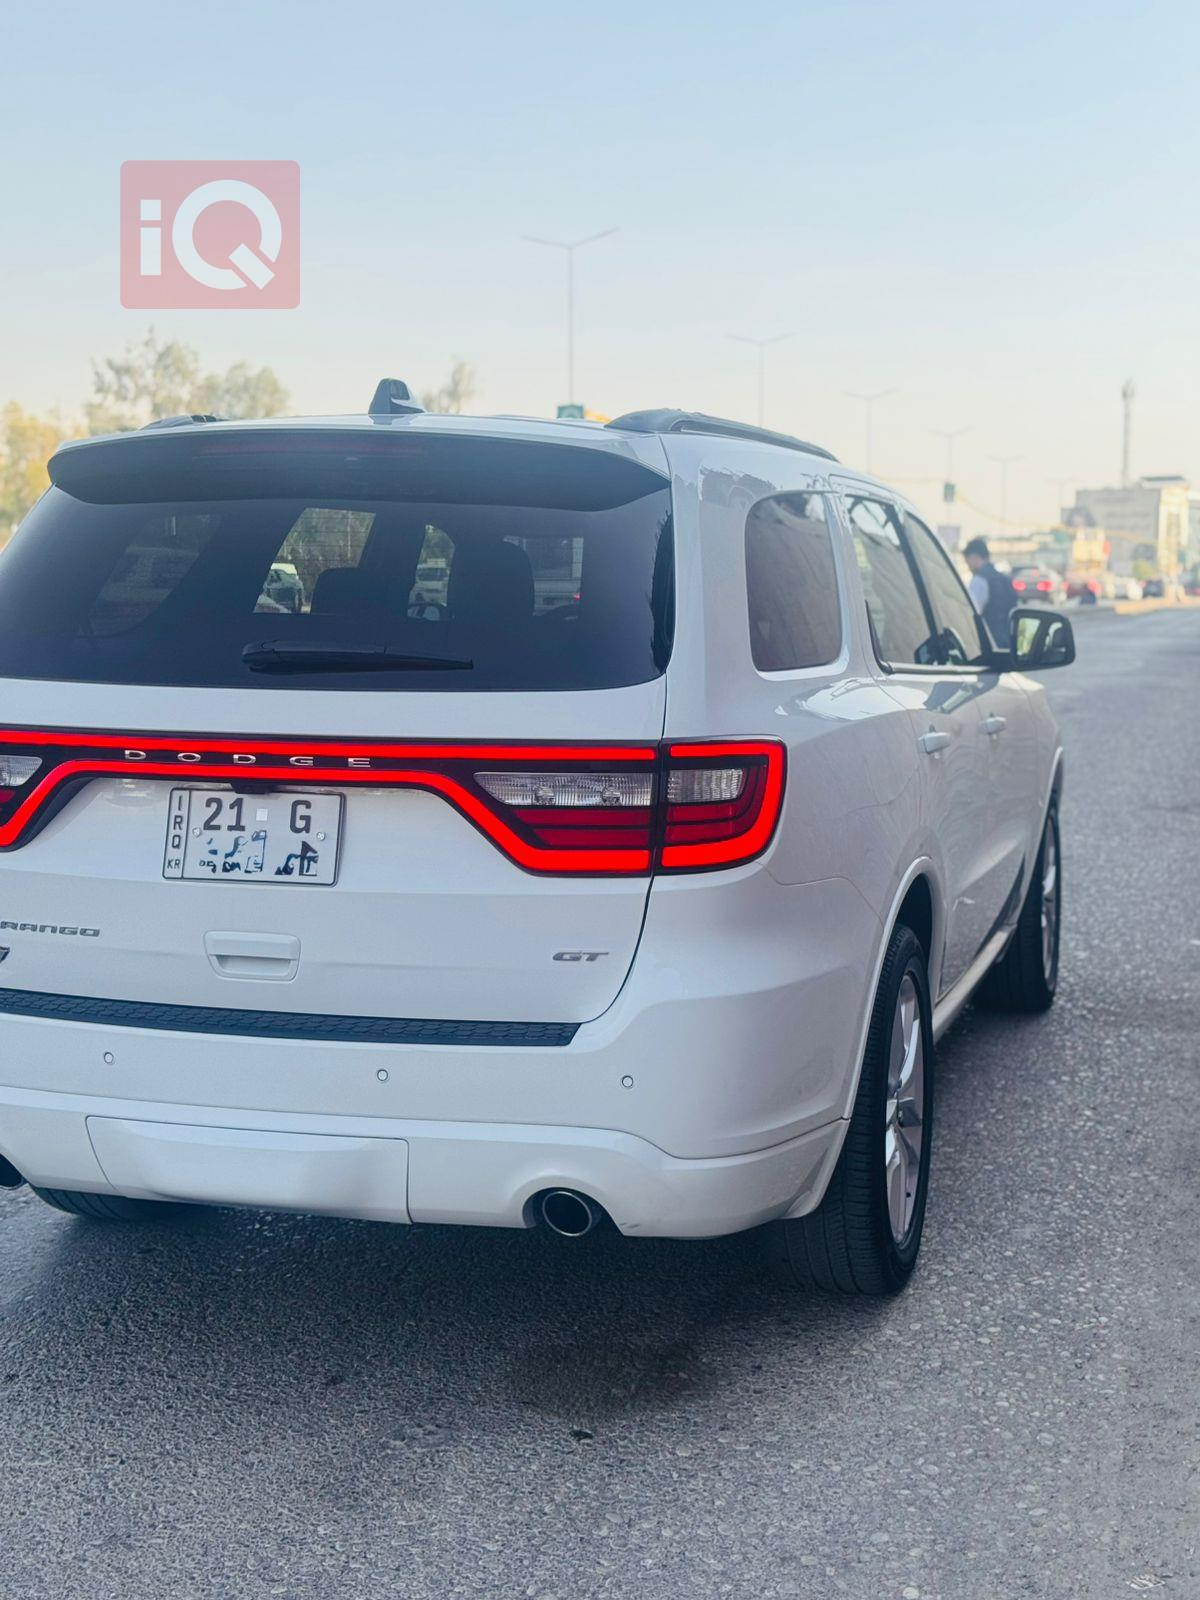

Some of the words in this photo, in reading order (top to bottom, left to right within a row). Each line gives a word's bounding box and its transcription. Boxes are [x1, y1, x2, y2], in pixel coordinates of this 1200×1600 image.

[124, 750, 371, 768] DODGE
[171, 795, 183, 849] IRQ
[203, 797, 246, 831] 21
[289, 799, 312, 834] G
[167, 857, 181, 869] KR
[0, 921, 100, 937] RANGO
[552, 952, 609, 962] GT
